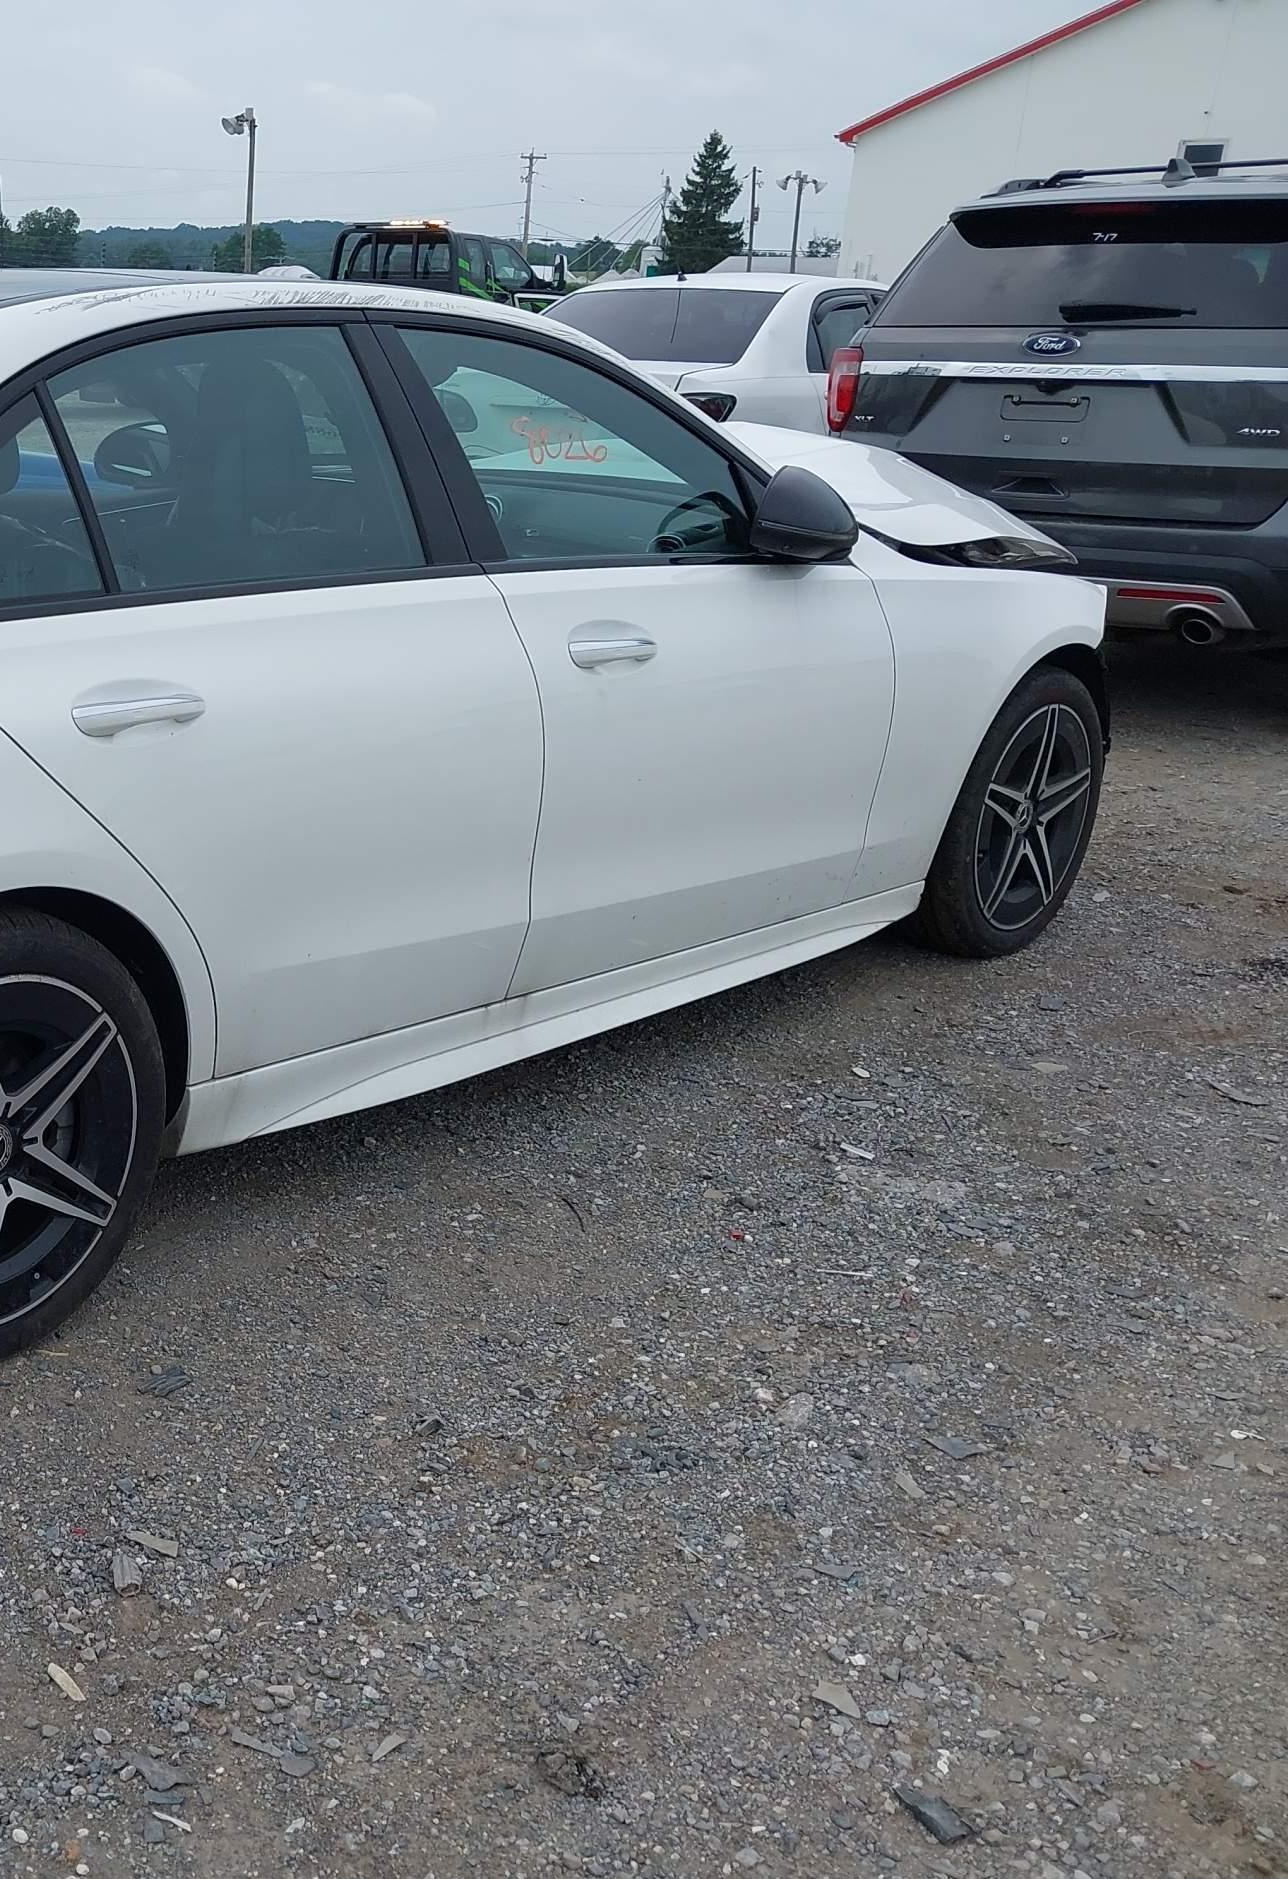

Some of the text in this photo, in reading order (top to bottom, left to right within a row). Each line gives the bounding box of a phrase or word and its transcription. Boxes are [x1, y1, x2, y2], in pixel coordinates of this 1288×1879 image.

[1032, 336, 1065, 351] Ford
[967, 365, 1127, 377] EXPLORER
[854, 415, 875, 423] XLT
